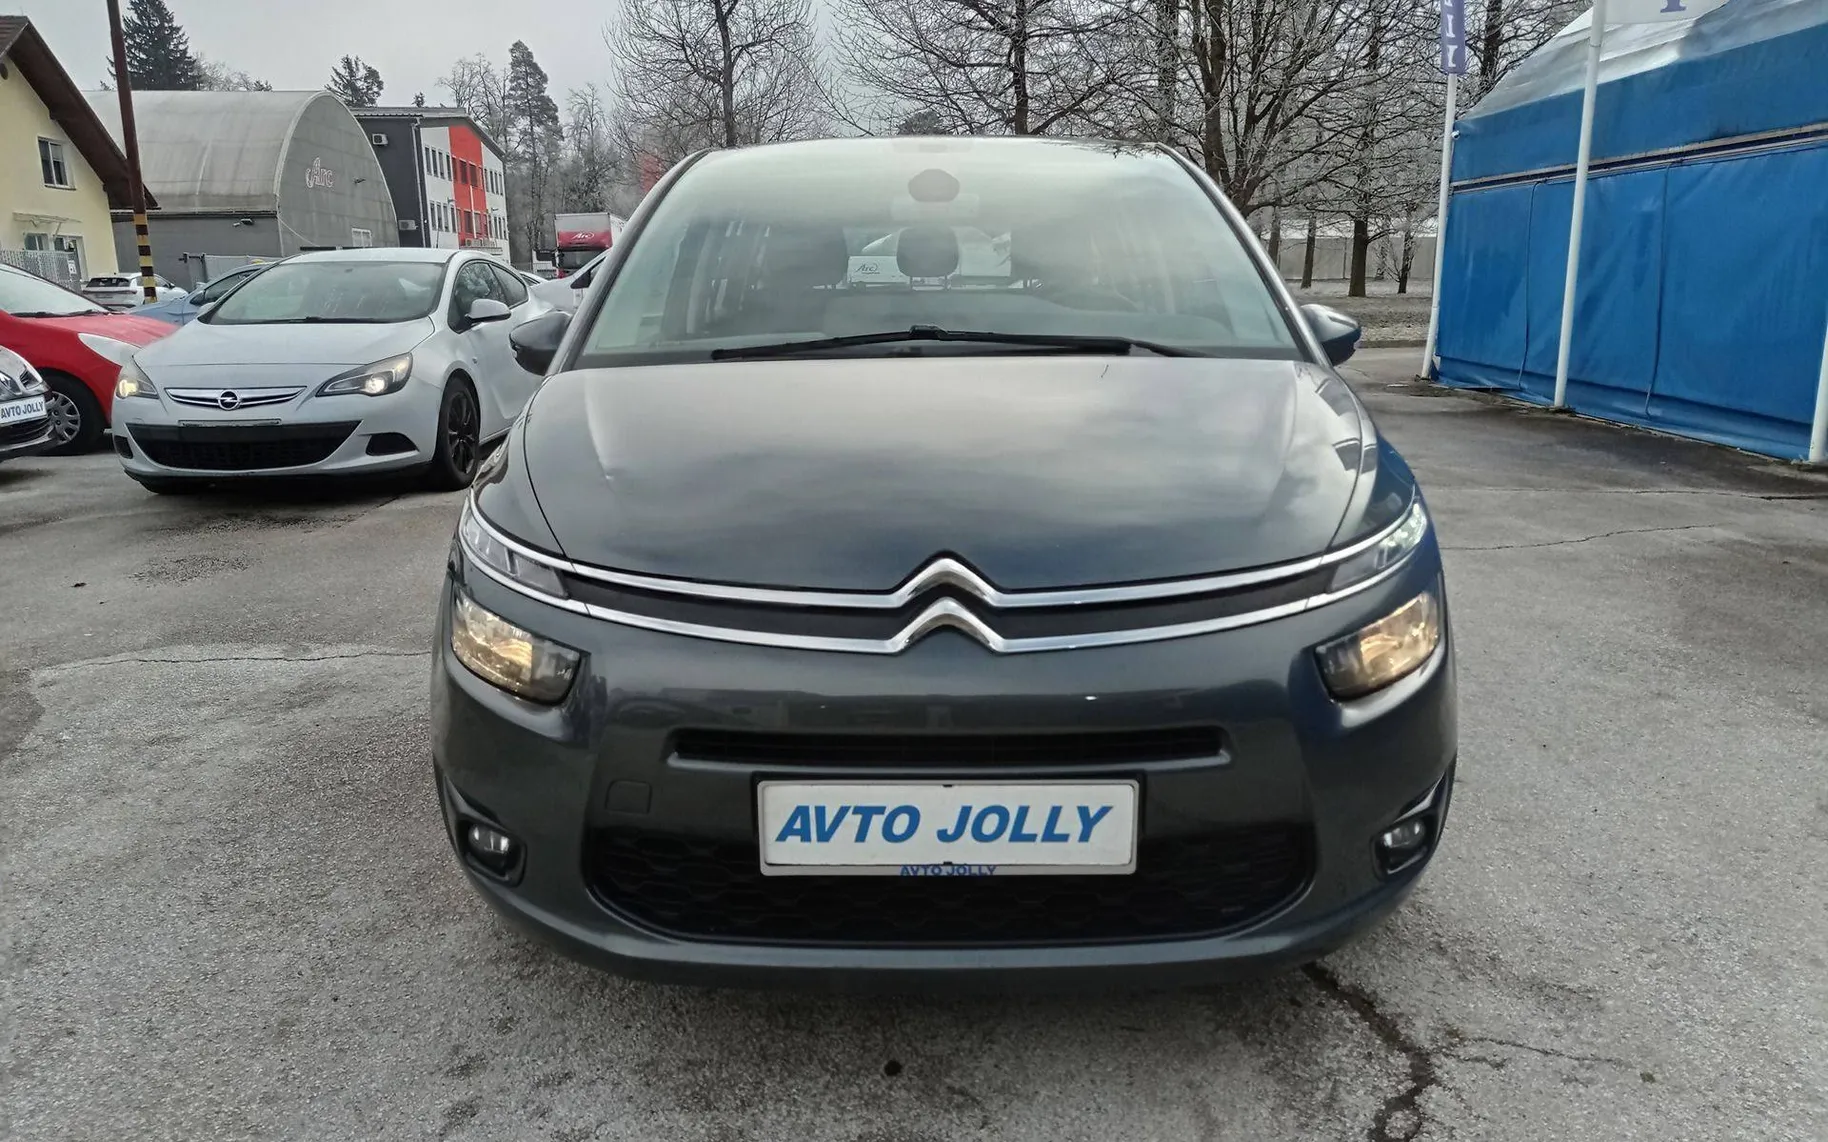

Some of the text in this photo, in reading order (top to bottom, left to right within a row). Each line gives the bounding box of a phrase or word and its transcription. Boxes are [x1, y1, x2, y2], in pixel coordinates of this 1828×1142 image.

[0, 401, 44, 419] AVTO JOLLY
[775, 804, 1114, 844] AVTO JOLLY
[900, 865, 997, 876] AVTO JOLLY
